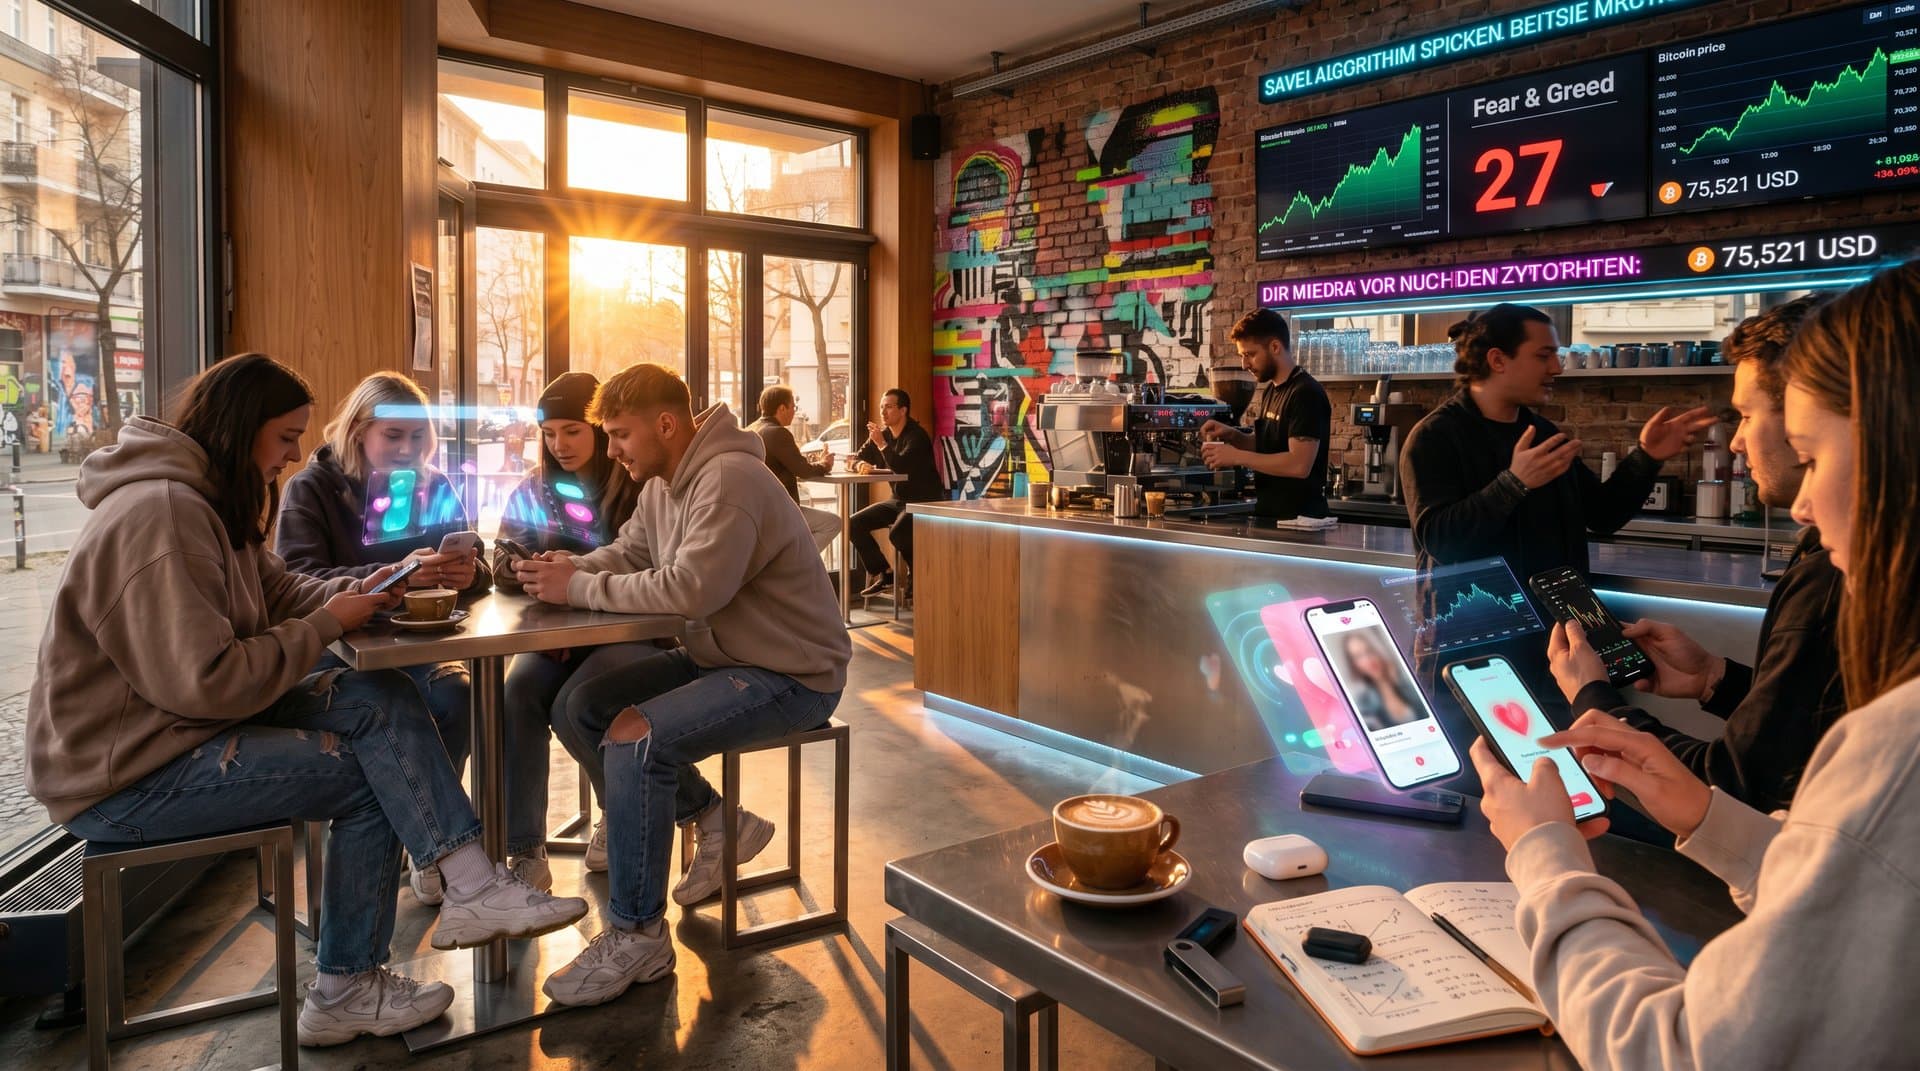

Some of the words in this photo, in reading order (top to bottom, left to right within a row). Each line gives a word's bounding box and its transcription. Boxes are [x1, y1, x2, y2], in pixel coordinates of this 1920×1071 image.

[1658, 47, 1696, 63] Bitcoin
[1697, 42, 1726, 57] price
[1473, 94, 1520, 118] Fear
[1524, 87, 1541, 108] &
[1546, 70, 1615, 104] Greed
[1474, 139, 1563, 213] 27
[1686, 175, 1748, 199] 75,521
[1757, 169, 1799, 190] USD
[1721, 240, 1806, 269] 75,521
[1818, 234, 1877, 260] USD
[1262, 286, 1289, 302] DIR
[1360, 276, 1396, 295] VOR
